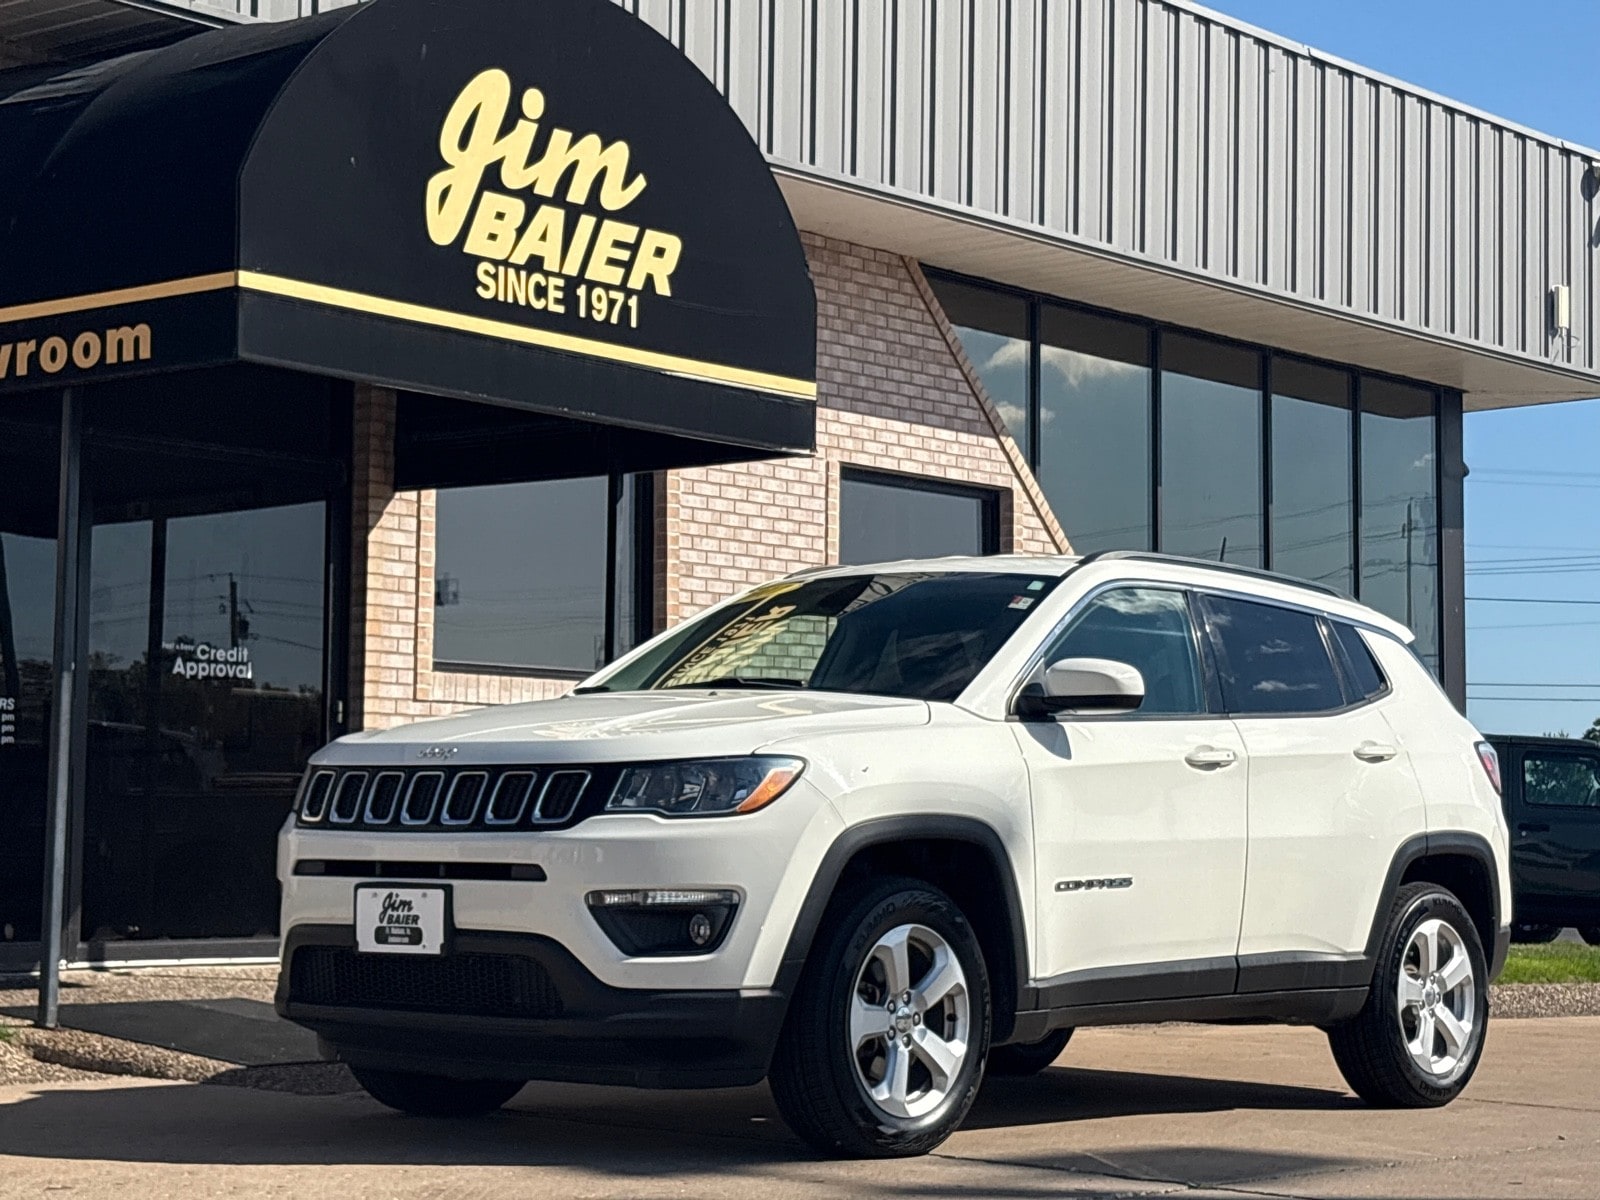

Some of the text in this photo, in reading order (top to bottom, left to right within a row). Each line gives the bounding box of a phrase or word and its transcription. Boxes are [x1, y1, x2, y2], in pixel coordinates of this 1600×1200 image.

[426, 68, 647, 246] Jim
[463, 190, 682, 297] BAIER
[476, 261, 639, 328] SINCE 1971
[196, 644, 249, 663] Credit
[172, 656, 252, 679] Approval
[1054, 877, 1133, 892] COMPASS
[379, 892, 414, 924] Jim
[386, 914, 420, 926] BAIER
